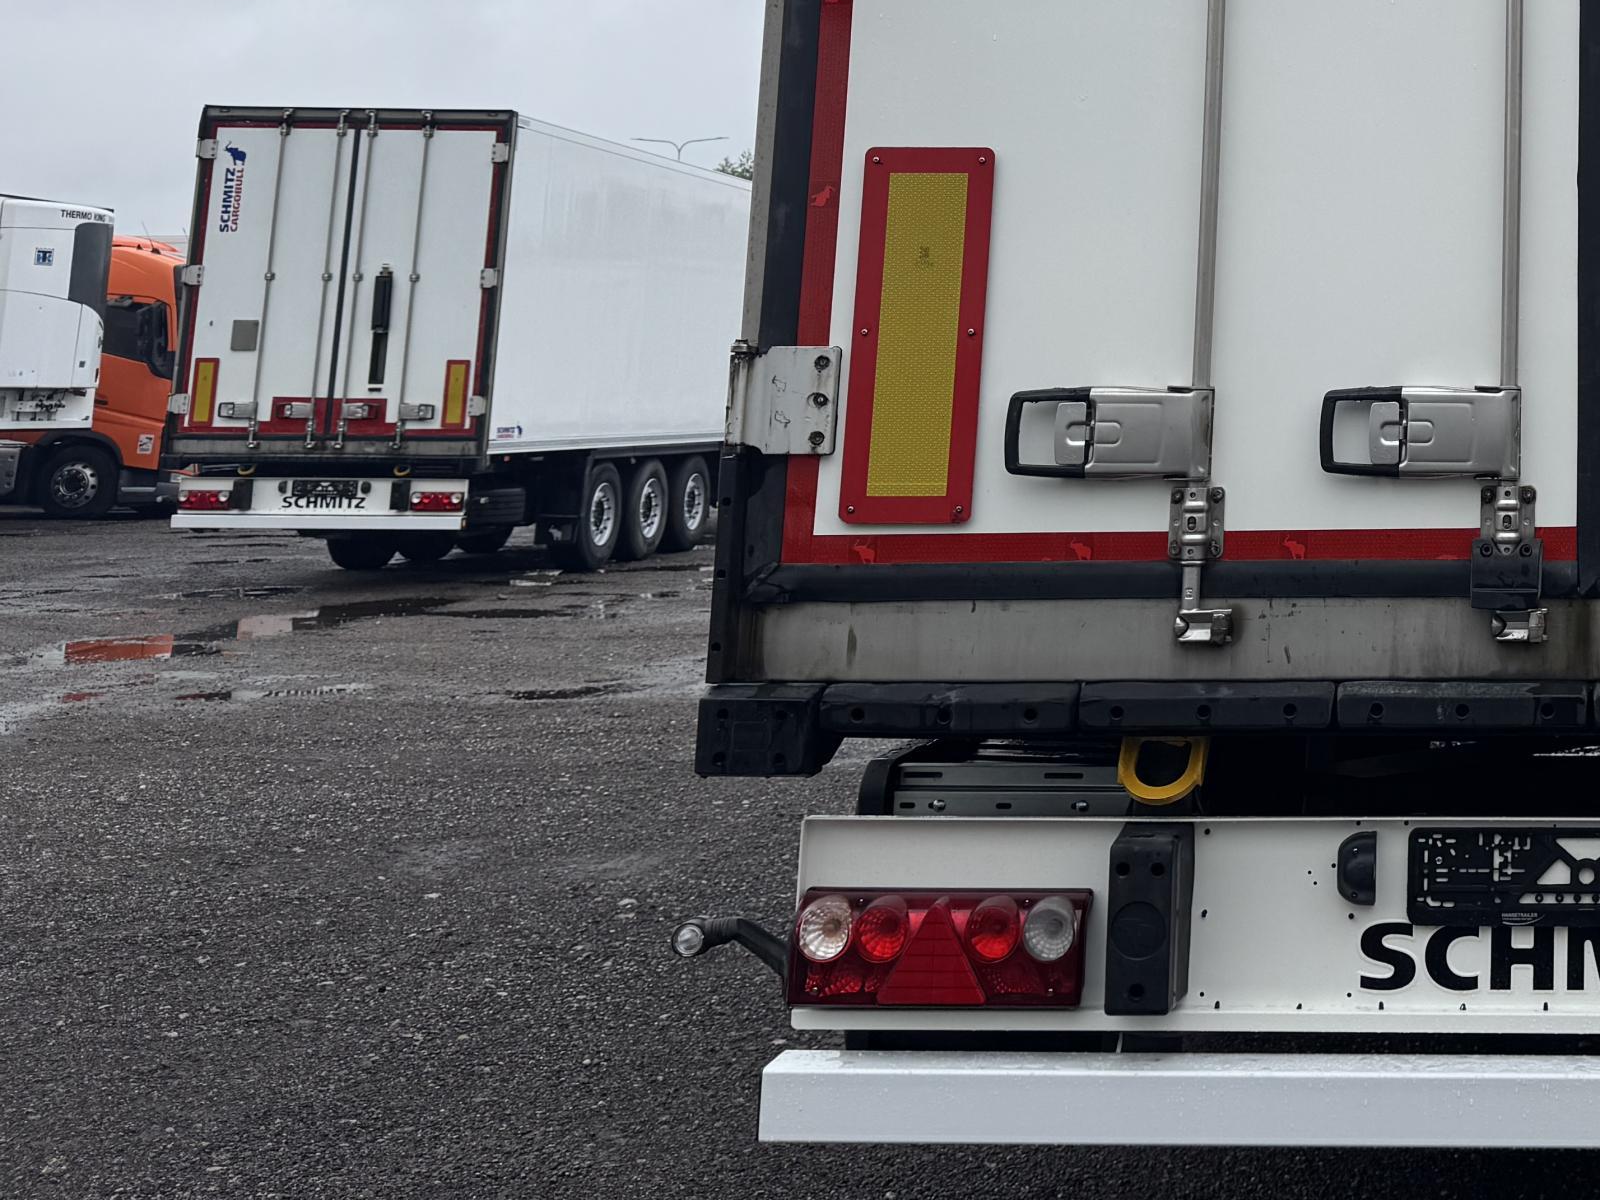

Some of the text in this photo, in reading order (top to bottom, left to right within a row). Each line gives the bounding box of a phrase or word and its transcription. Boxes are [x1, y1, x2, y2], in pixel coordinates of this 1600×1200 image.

[60, 209, 106, 222] THERMO KING
[219, 167, 236, 232] SCHMITZ
[230, 167, 245, 232] CARGOBULL
[281, 496, 366, 509] SCHMITZ
